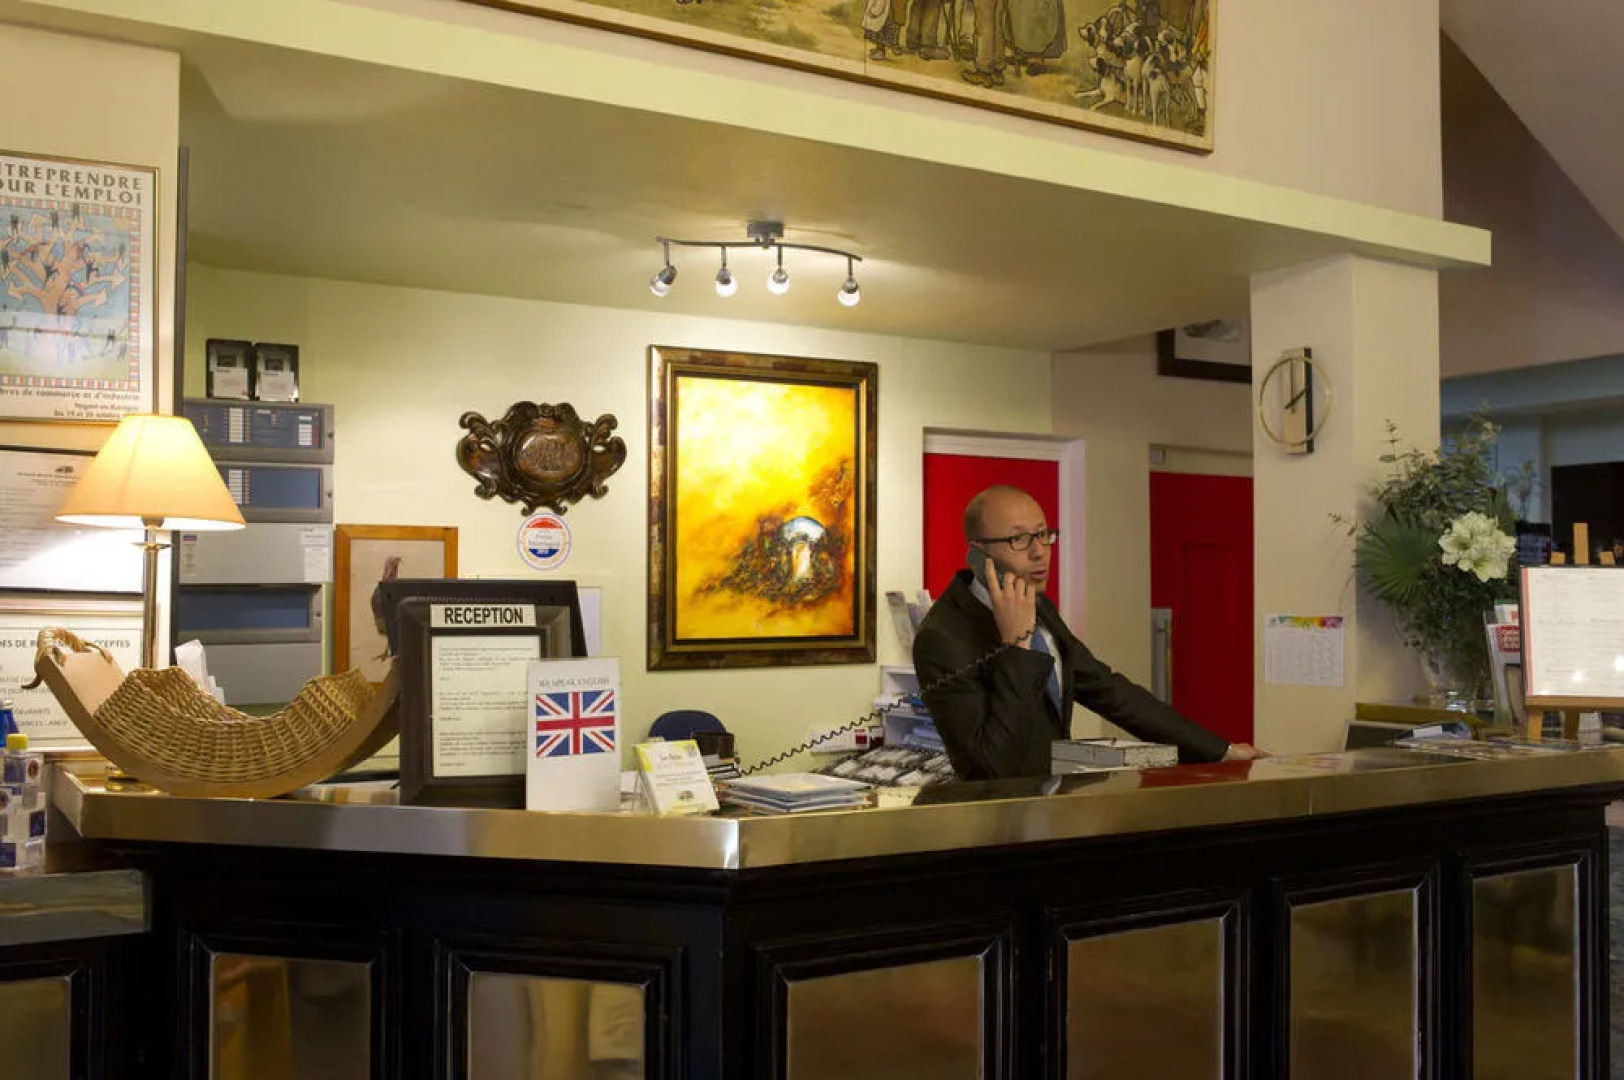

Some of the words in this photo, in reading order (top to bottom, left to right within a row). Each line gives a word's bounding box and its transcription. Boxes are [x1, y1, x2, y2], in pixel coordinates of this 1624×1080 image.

[0, 163, 143, 191] TREPRENDRE
[45, 183, 141, 204] L'EMPLOI
[444, 607, 524, 624] RECEPTION
